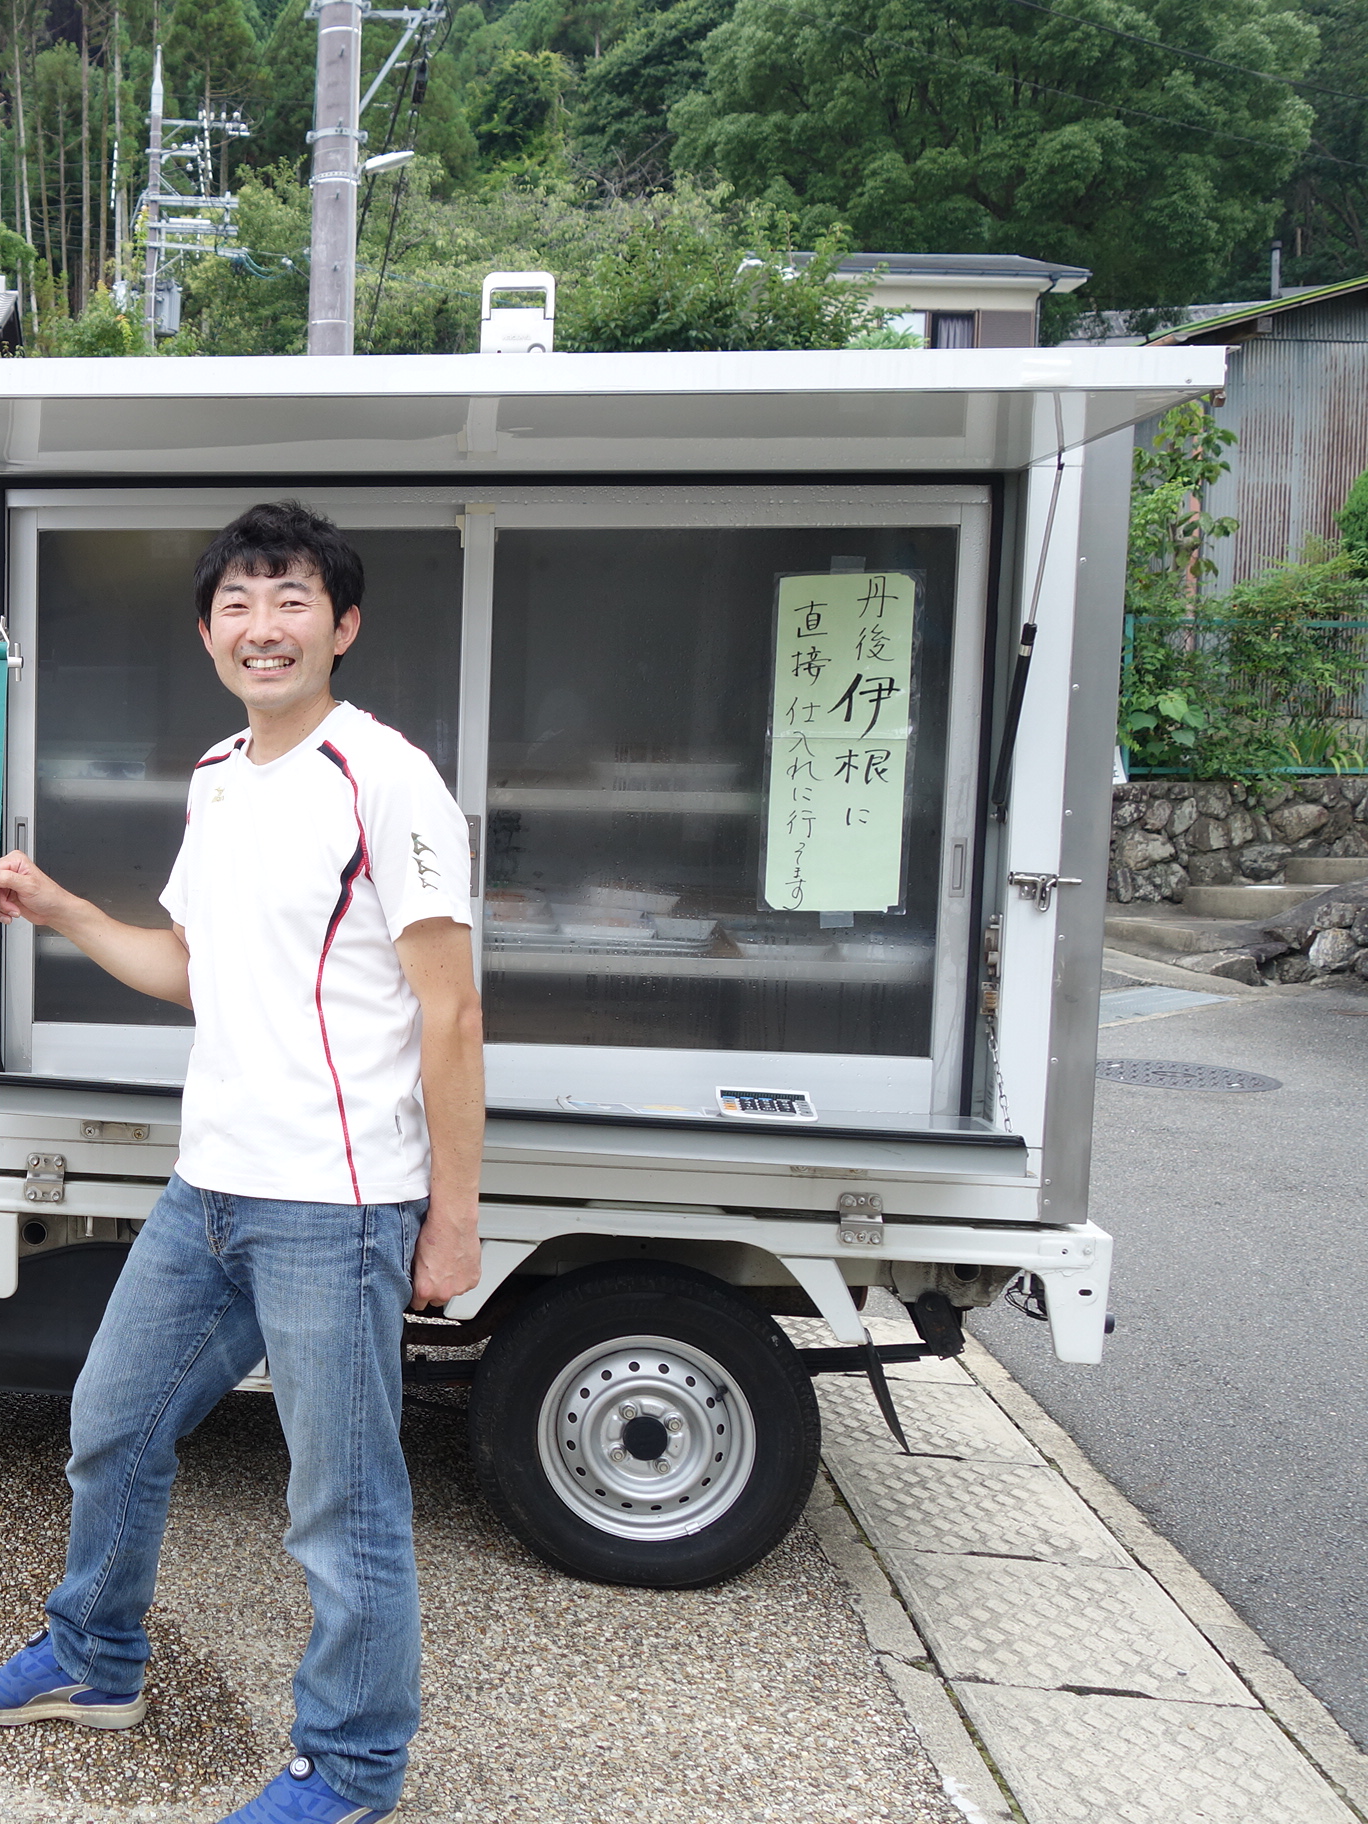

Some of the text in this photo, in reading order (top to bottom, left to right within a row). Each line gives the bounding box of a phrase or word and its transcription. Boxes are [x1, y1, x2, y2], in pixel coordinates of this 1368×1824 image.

[828, 575, 900, 826] 丹後伊根に
